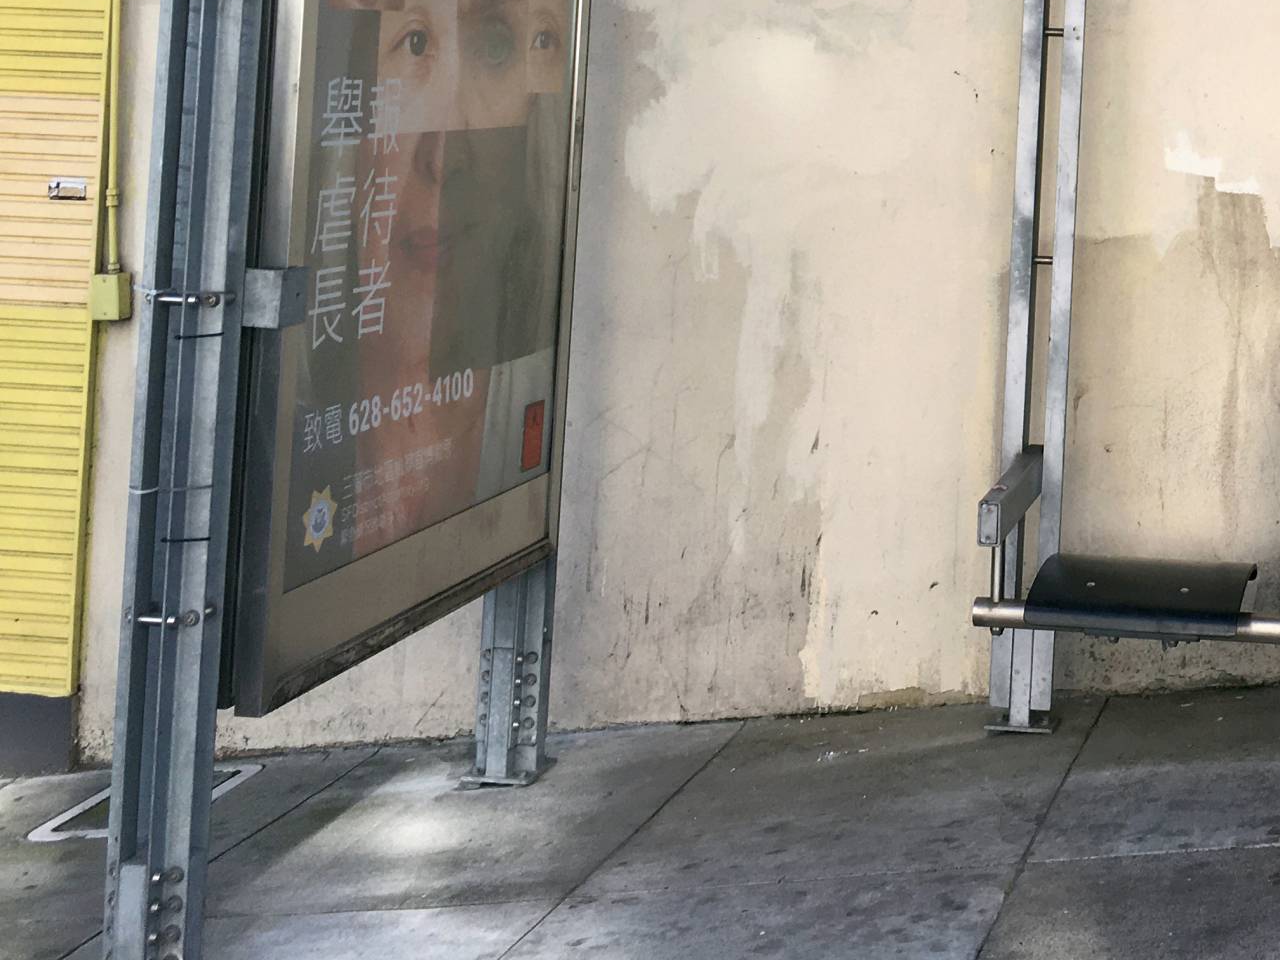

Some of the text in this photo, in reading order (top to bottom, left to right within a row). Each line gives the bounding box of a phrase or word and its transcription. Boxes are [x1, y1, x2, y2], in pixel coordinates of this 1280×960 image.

[320, 75, 403, 158] 舉報
[310, 168, 399, 256] 虐待
[307, 258, 391, 351] 長者
[348, 368, 474, 436] 628-652-4100
